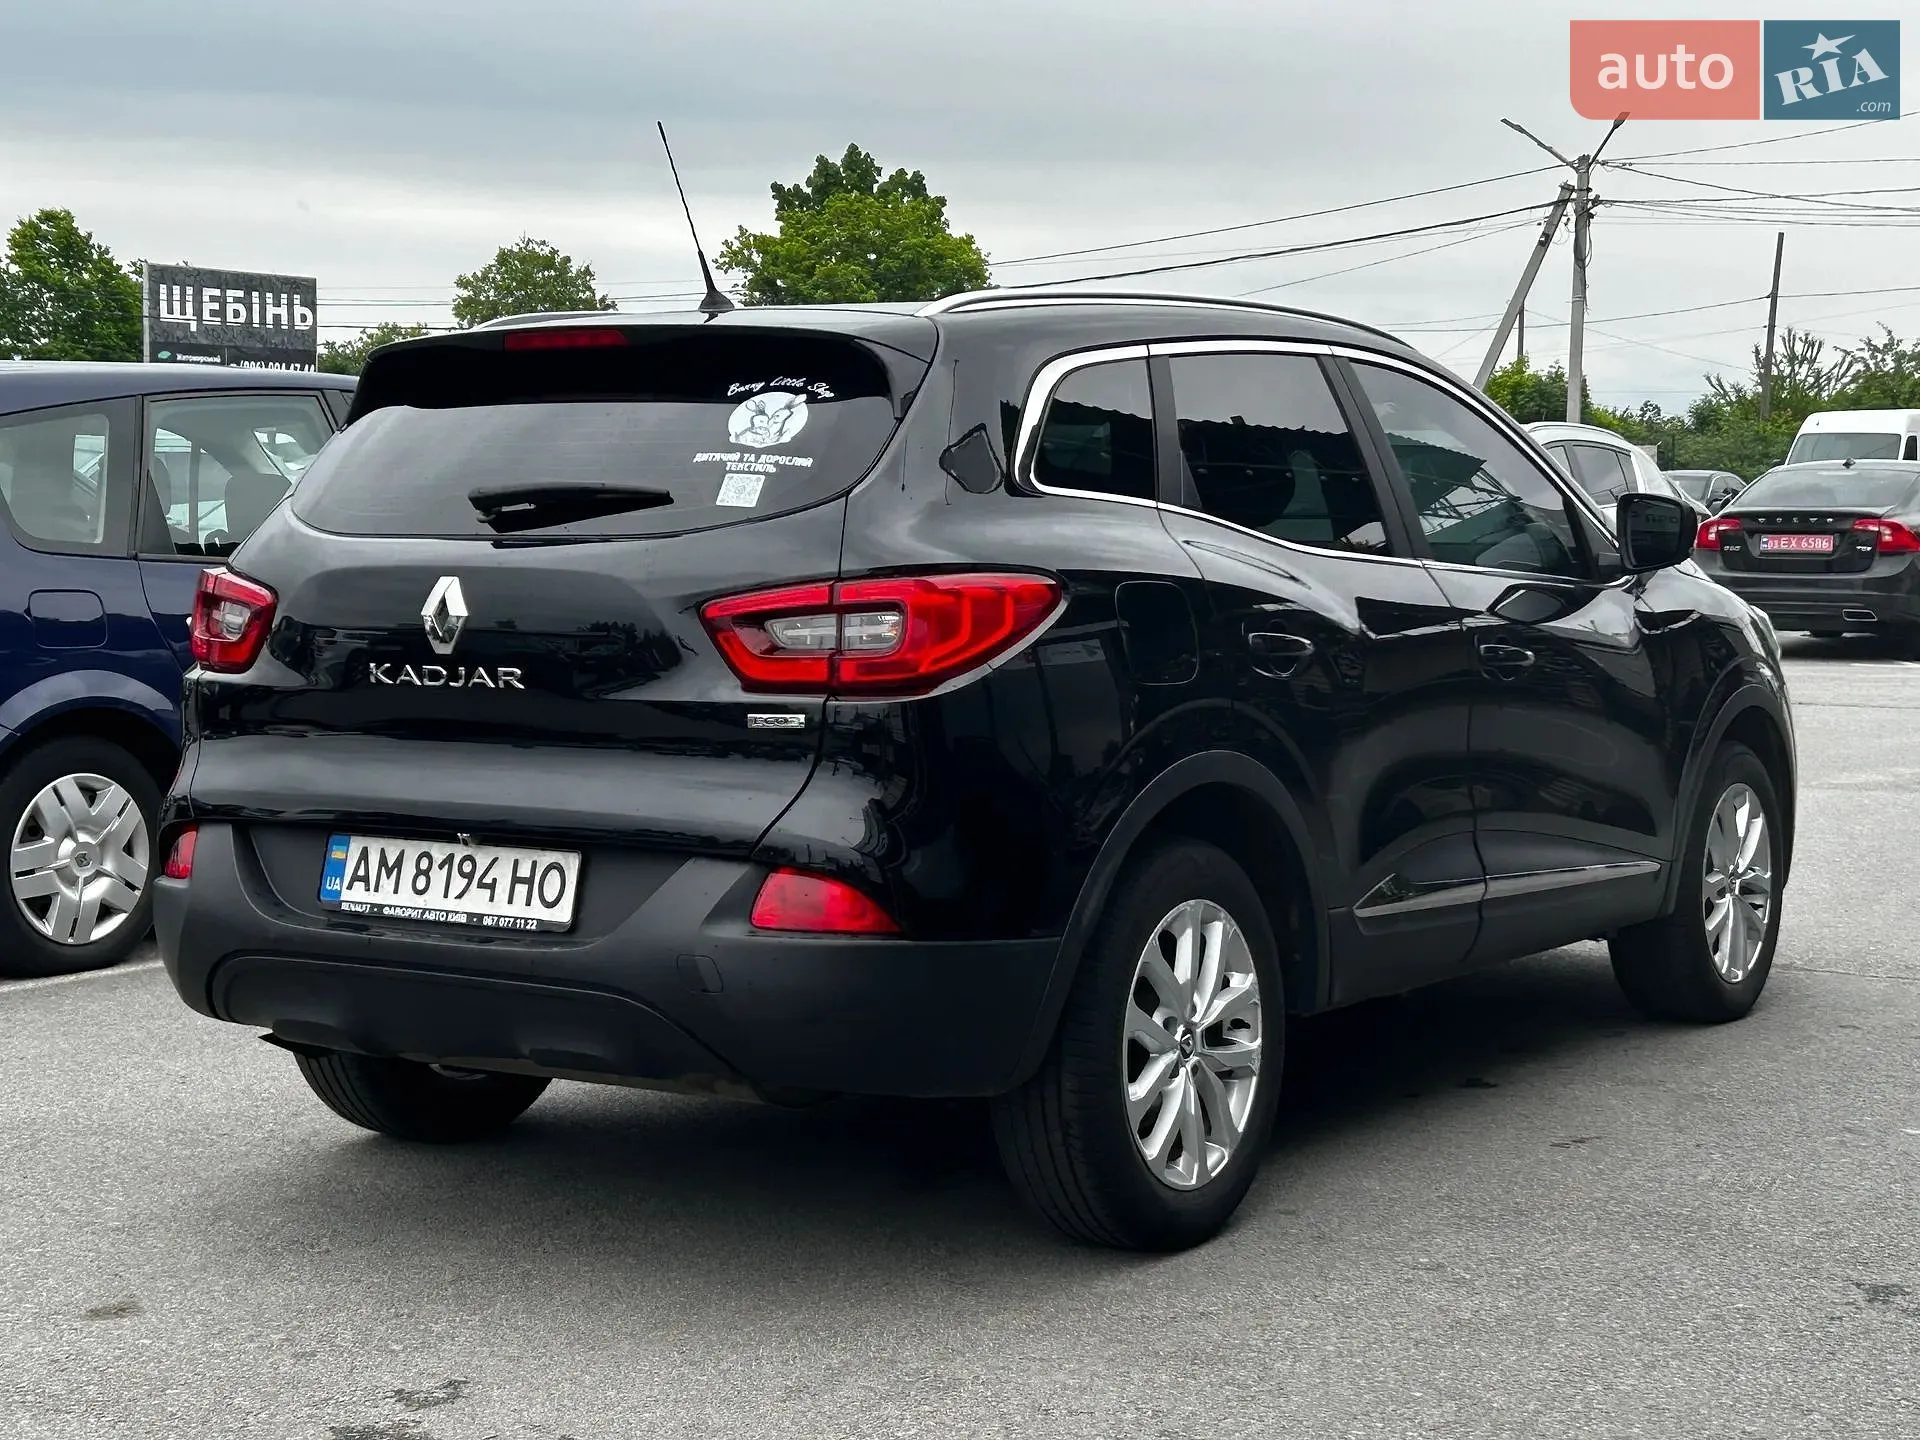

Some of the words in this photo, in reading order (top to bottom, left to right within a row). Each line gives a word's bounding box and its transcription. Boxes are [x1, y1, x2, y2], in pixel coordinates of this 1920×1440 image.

[159, 283, 314, 332] ЩЕБІНЬ
[368, 662, 525, 690] KADJAR
[326, 876, 341, 892] UA
[346, 846, 406, 895] AM
[411, 851, 500, 903] 8194
[507, 858, 567, 910] HO
